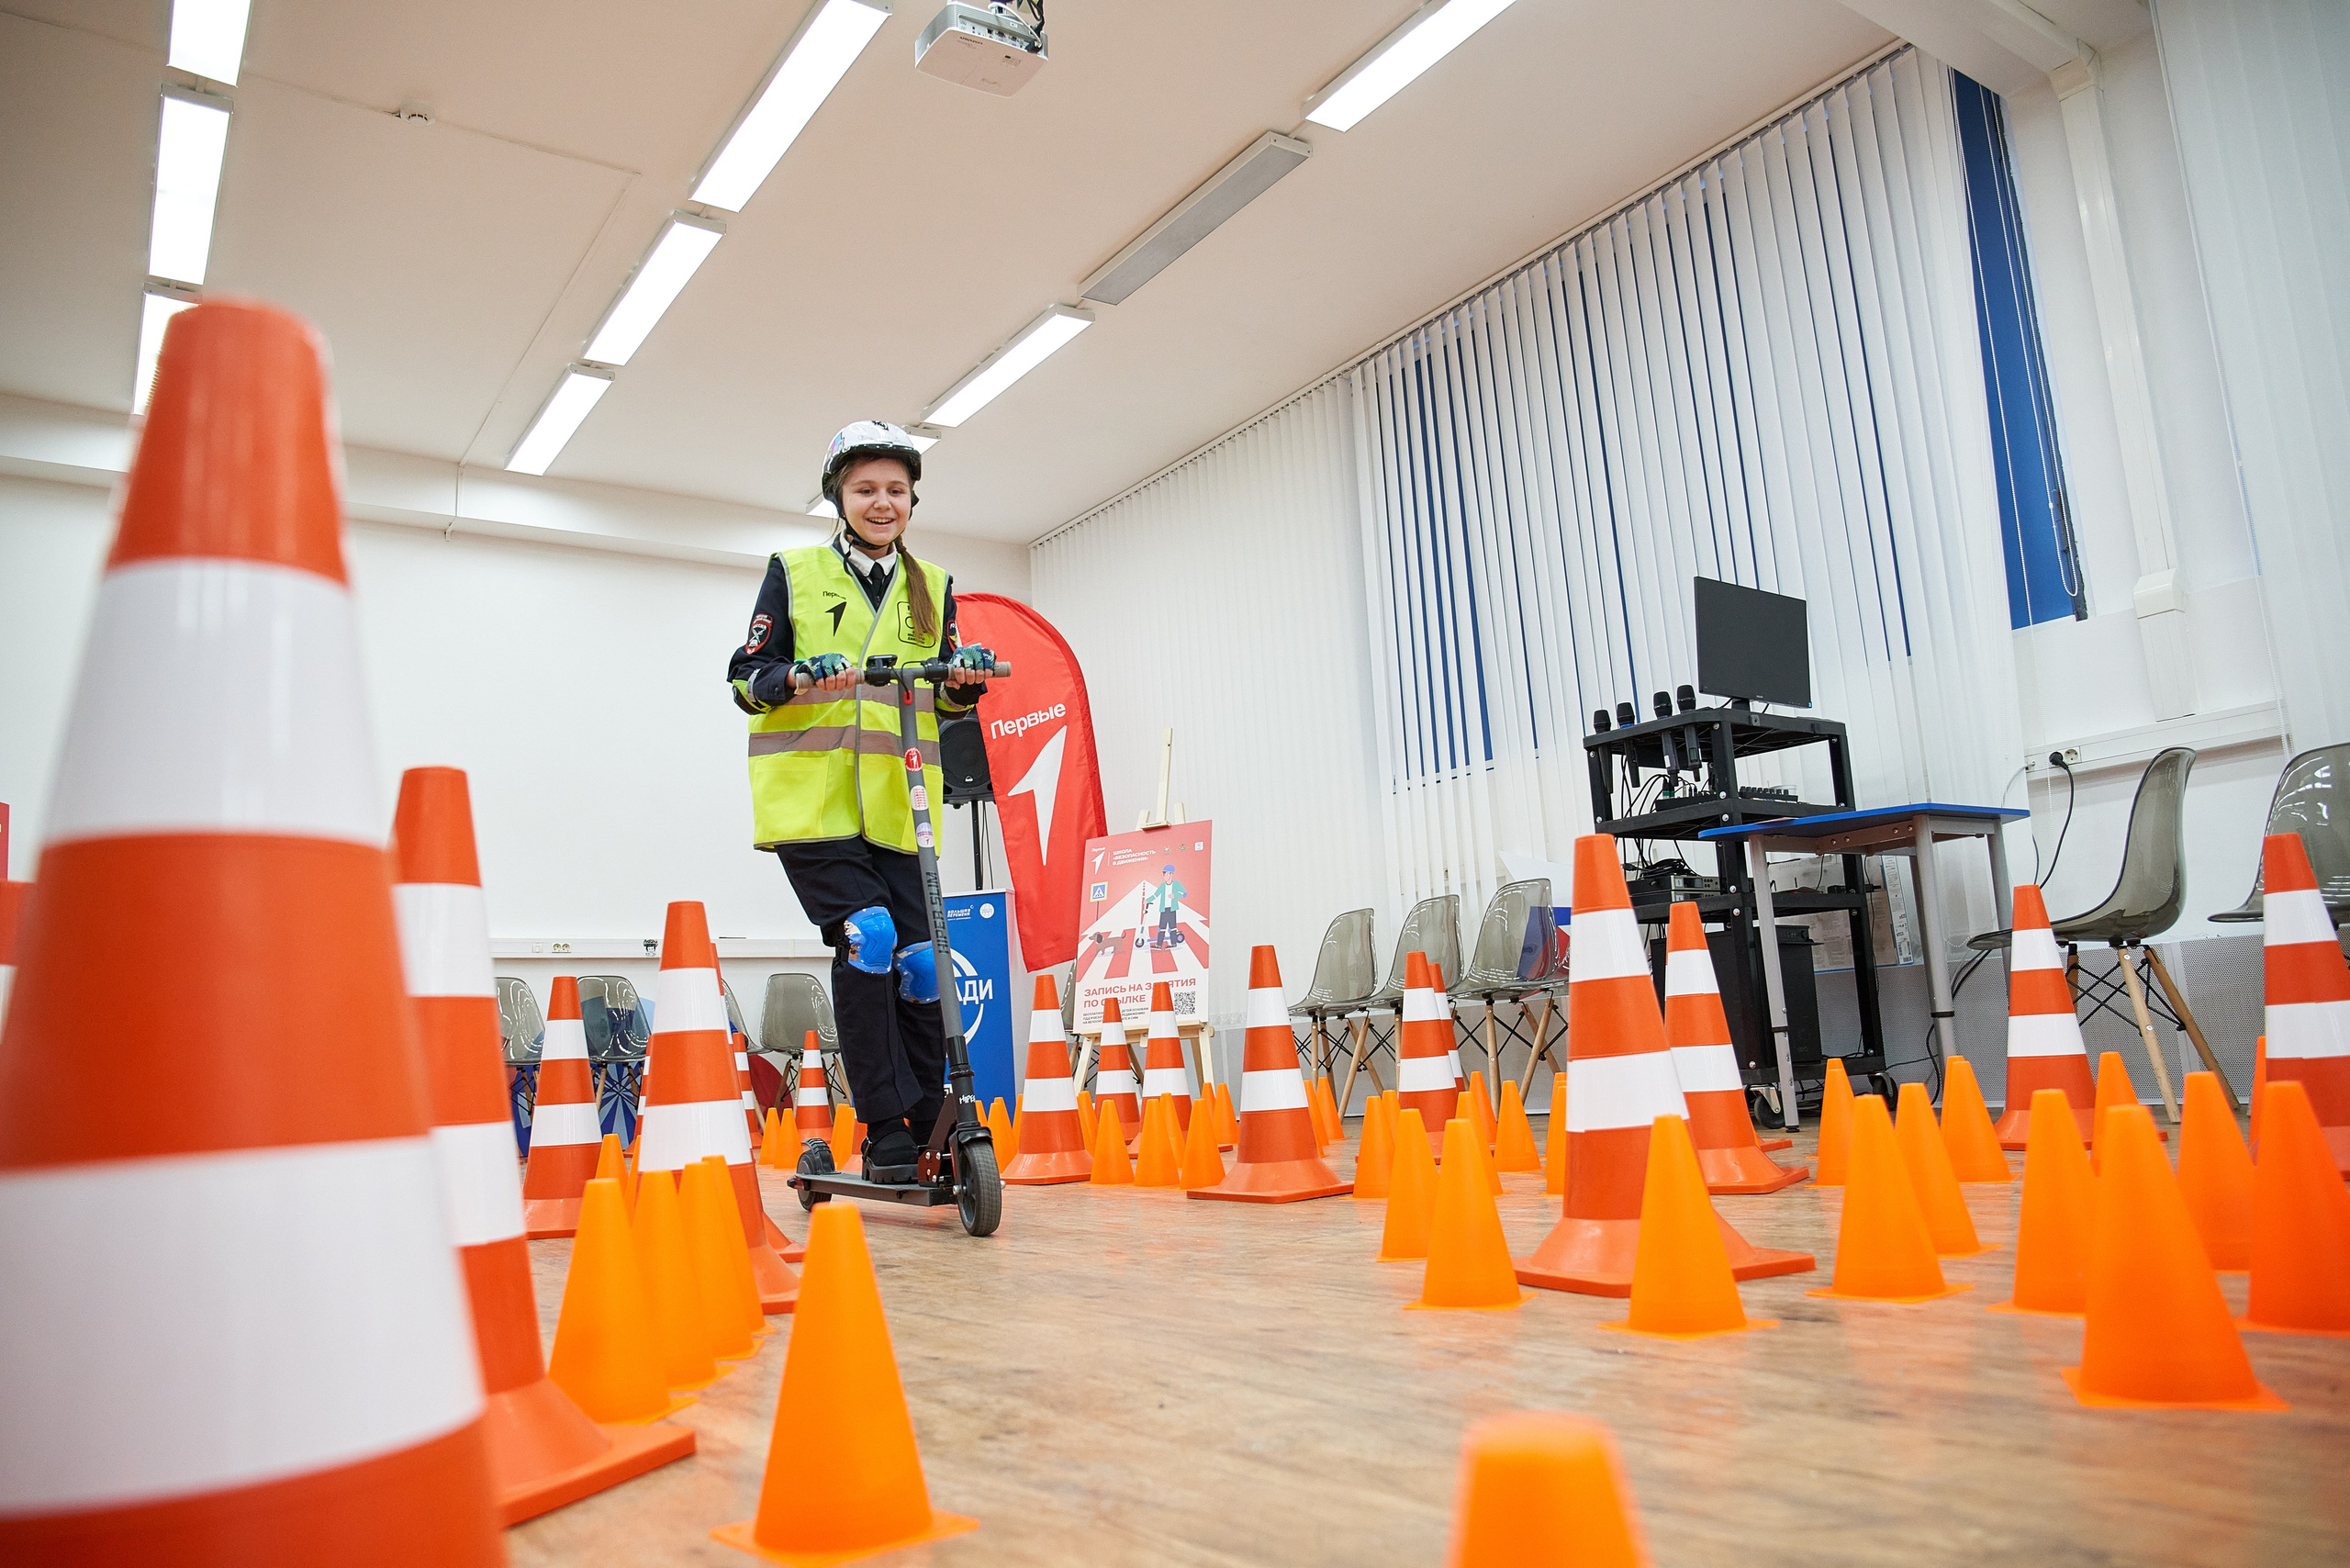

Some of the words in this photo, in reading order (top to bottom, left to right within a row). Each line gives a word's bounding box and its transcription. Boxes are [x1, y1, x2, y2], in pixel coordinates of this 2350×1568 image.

[990, 703, 1067, 740] Первые
[926, 871, 942, 907] SLIM
[933, 910, 949, 954] HIPER
[1084, 985, 1126, 997] ЗАПИСЬ
[1128, 983, 1143, 992] НА
[1145, 978, 1196, 991] ЗЯТИЯ
[1084, 999, 1098, 1009] ПО
[1101, 994, 1146, 1006] СЫЛКЕ
